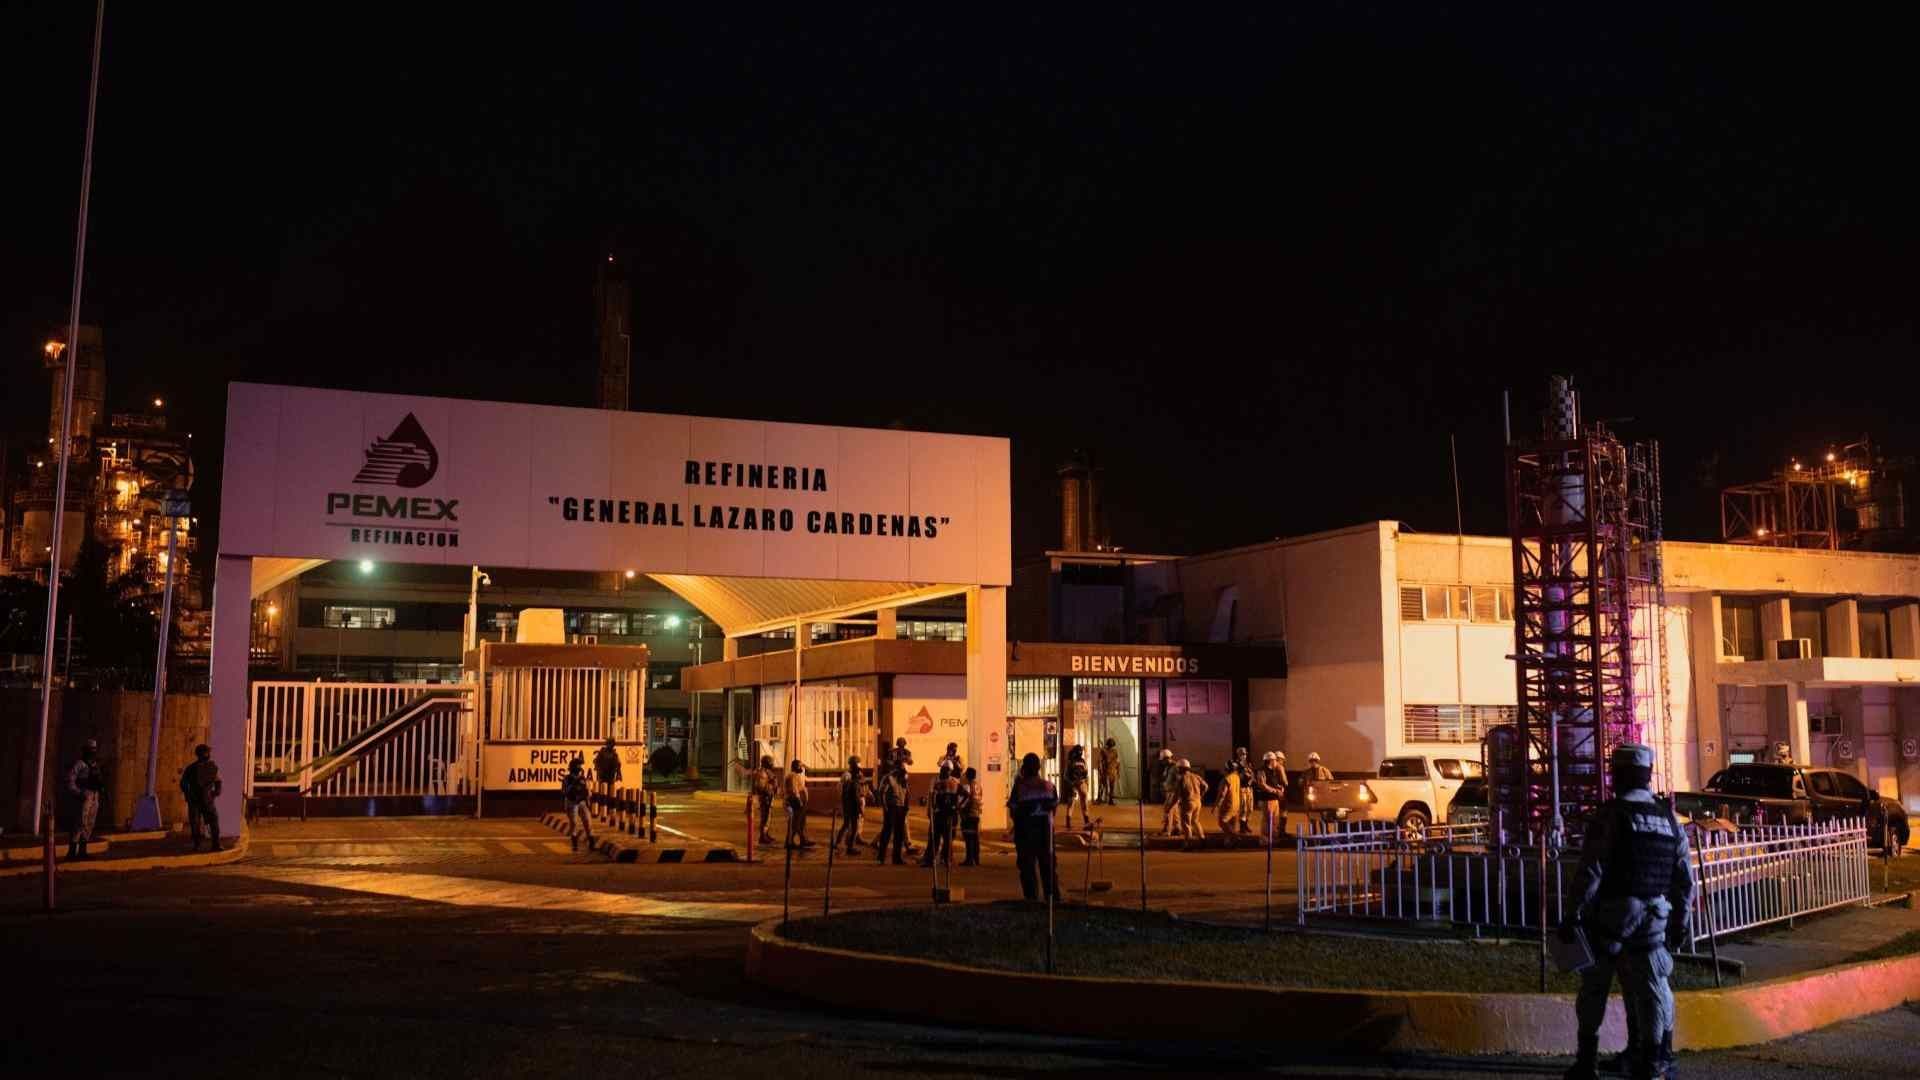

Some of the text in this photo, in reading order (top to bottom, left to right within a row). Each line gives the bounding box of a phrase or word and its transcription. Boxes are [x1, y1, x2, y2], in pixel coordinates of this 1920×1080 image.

[685, 460, 827, 492] REFINERIA
[327, 493, 459, 521] PEMEX
[693, 504, 793, 532] LAZARO
[351, 528, 459, 547] REFINACION
[1071, 655, 1200, 674] BIENVENIDOS
[530, 749, 585, 765] PUERTA
